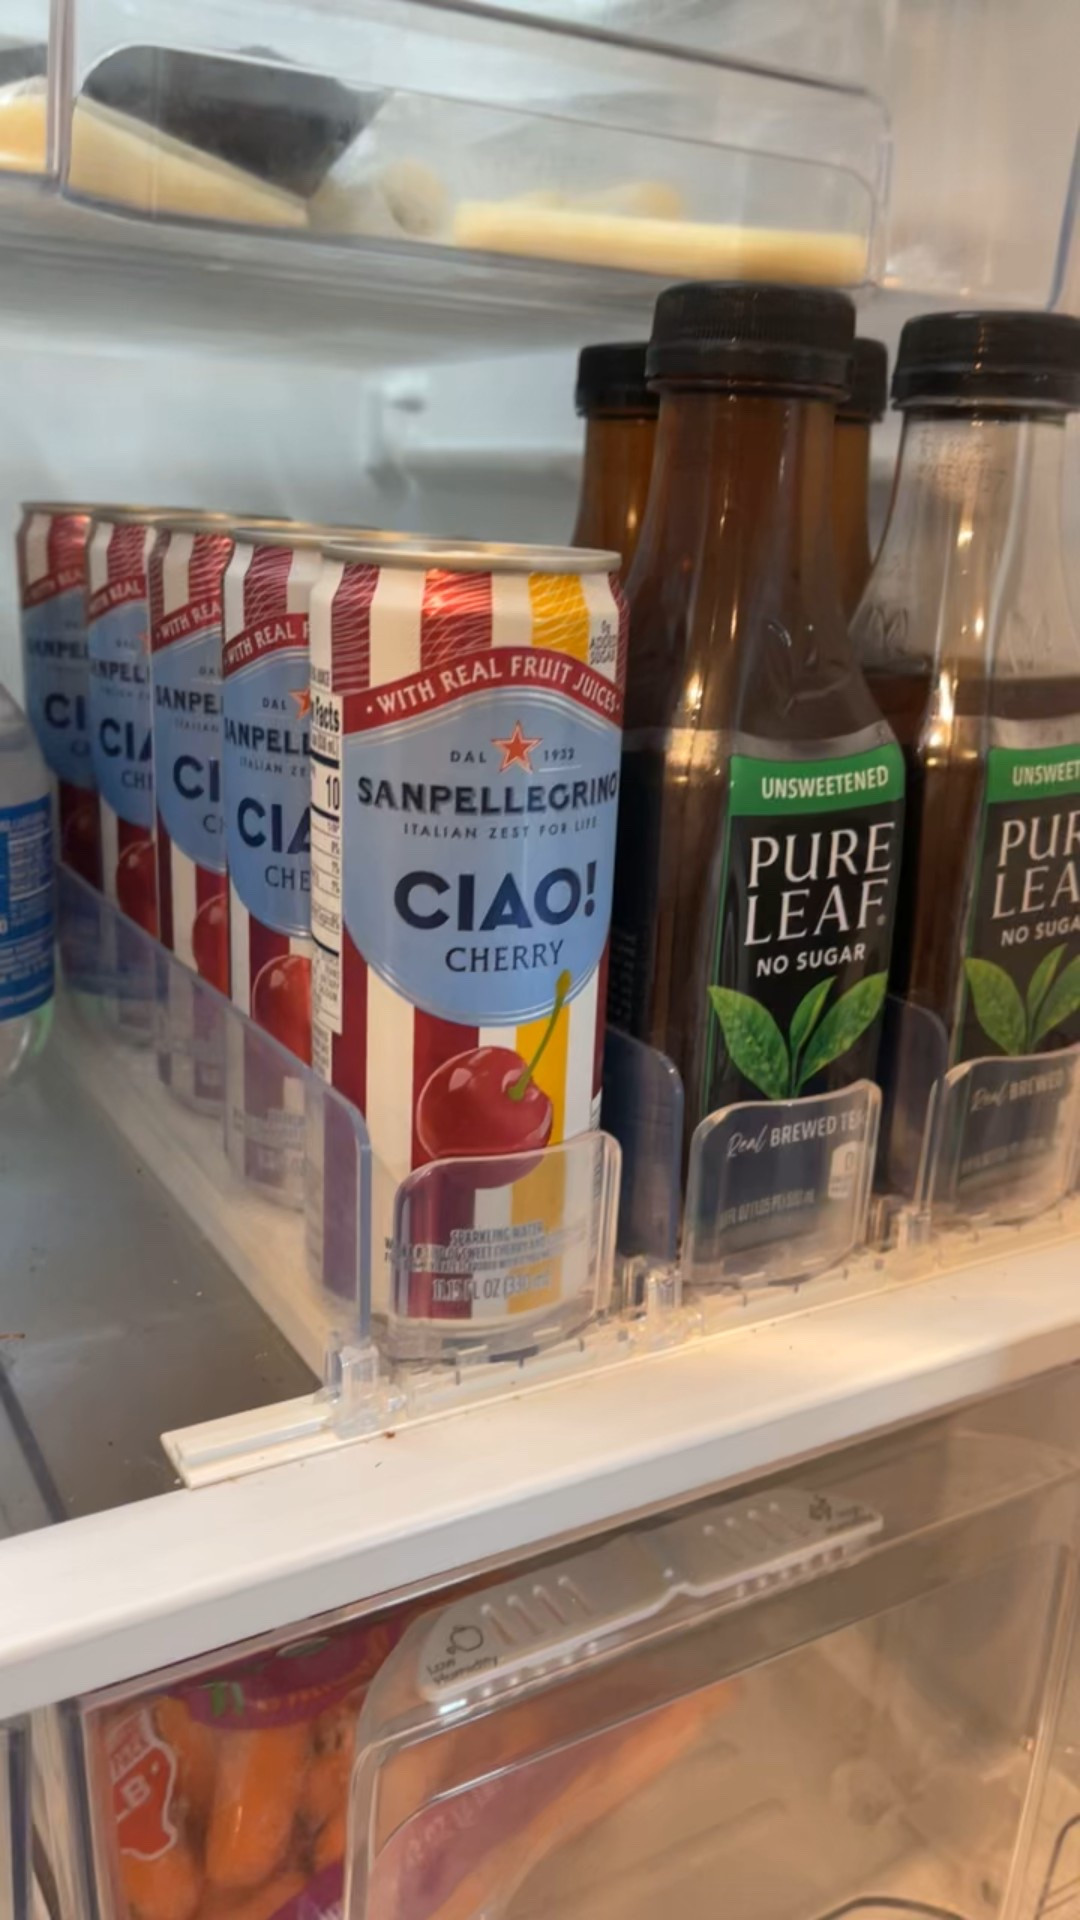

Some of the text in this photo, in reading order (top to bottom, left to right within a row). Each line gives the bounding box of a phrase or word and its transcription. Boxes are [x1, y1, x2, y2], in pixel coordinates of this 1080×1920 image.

[161, 616, 190, 640] WITH
[227, 637, 253, 666] WITH
[254, 621, 297, 650] REAL
[376, 655, 618, 716] WITH REAL FRUIT JUICES
[261, 697, 287, 711] DAL
[450, 750, 487, 764] DAL
[326, 774, 340, 811] 10
[357, 771, 618, 818] SANPELLEGRINO
[761, 765, 889, 799] UNSWEETENED
[403, 816, 597, 839] ITALIAN ZEST FOR LIFE
[747, 822, 896, 889] PURE
[394, 860, 598, 931] CIAO!
[744, 879, 889, 946] LEAF
[1001, 925, 1030, 947] NO
[445, 939, 564, 973] CHERRY
[756, 942, 866, 978] NO SUGAR
[726, 1123, 769, 1158] Real
[769, 1115, 838, 1148] BREWED
[483, 1277, 500, 1299] OZ
